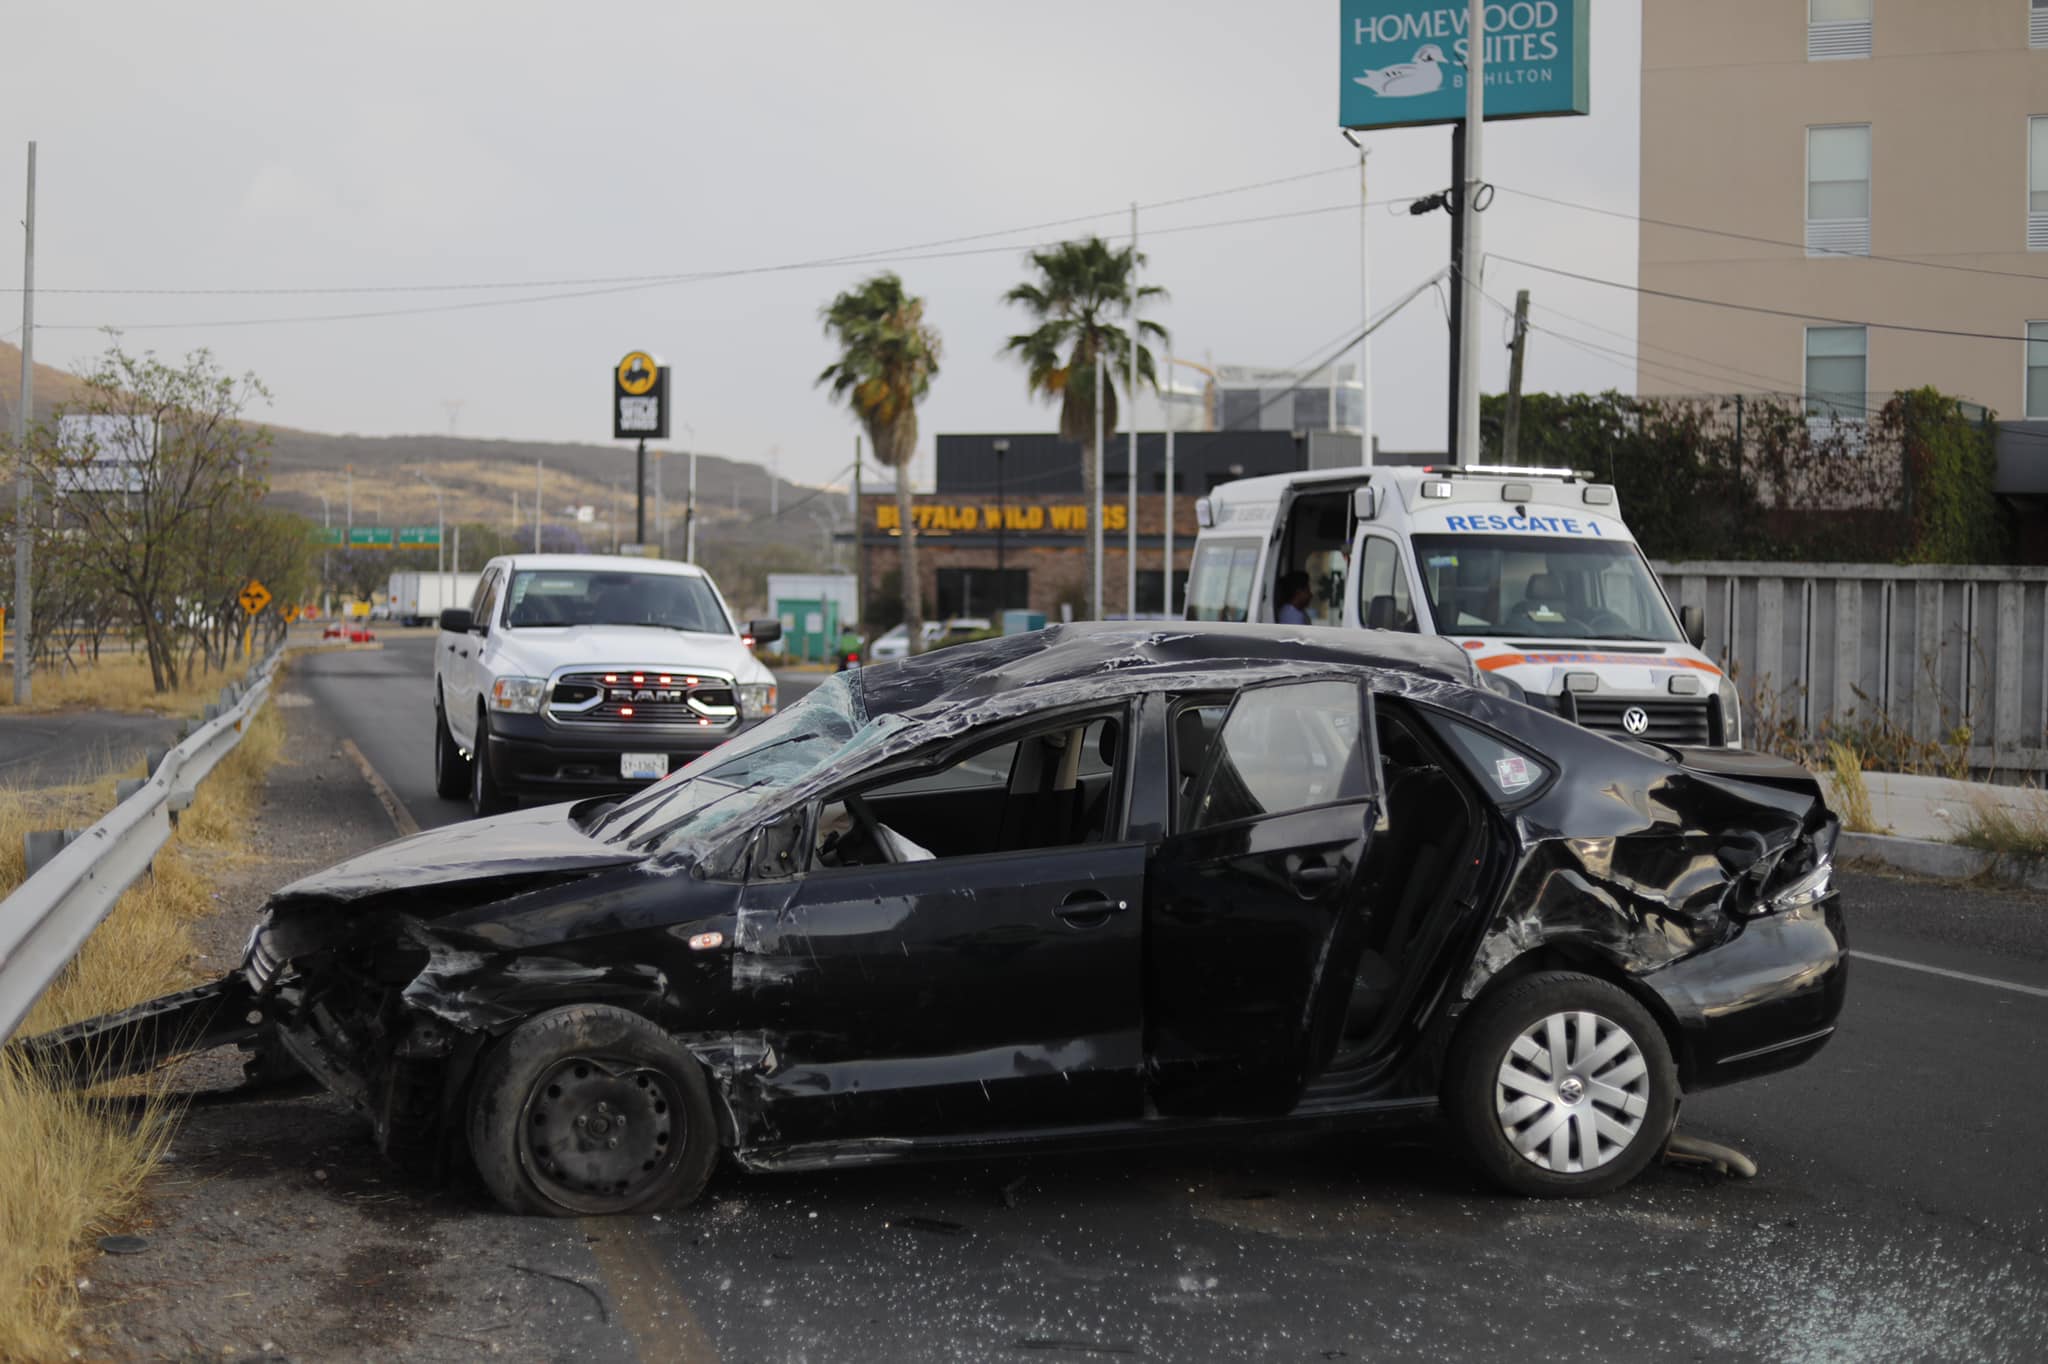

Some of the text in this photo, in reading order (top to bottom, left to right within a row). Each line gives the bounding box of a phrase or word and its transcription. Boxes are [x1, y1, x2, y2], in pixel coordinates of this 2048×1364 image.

[1484, 68, 1552, 86] HILTON
[984, 504, 1044, 529] WILD
[1446, 515, 1602, 536] RESCATE 1
[611, 689, 681, 703] RAM
